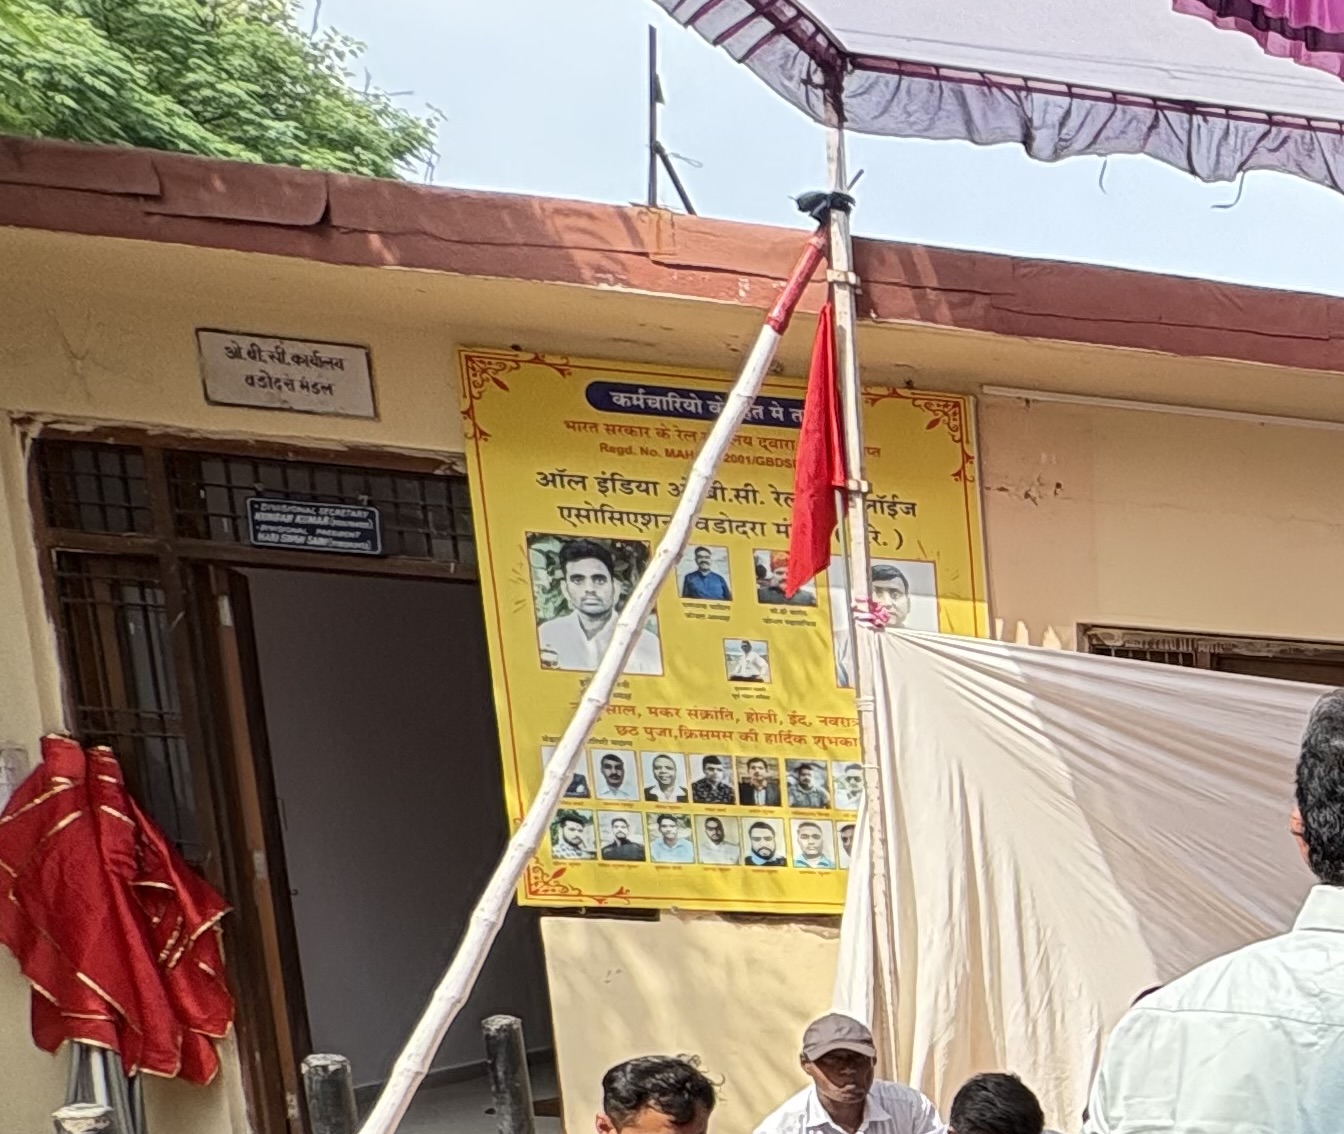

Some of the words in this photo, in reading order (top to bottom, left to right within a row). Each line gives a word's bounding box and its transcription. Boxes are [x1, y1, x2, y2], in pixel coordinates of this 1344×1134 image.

[564, 419, 599, 434] भारत
[602, 422, 652, 438] सरकार
[655, 423, 671, 439] के
[674, 425, 697, 442] रेल
[536, 468, 588, 491] ऑल
[593, 471, 661, 498] इंडिया
[694, 511, 767, 539] वडोदरा
[646, 705, 680, 719] मकर
[739, 727, 759, 742] की
